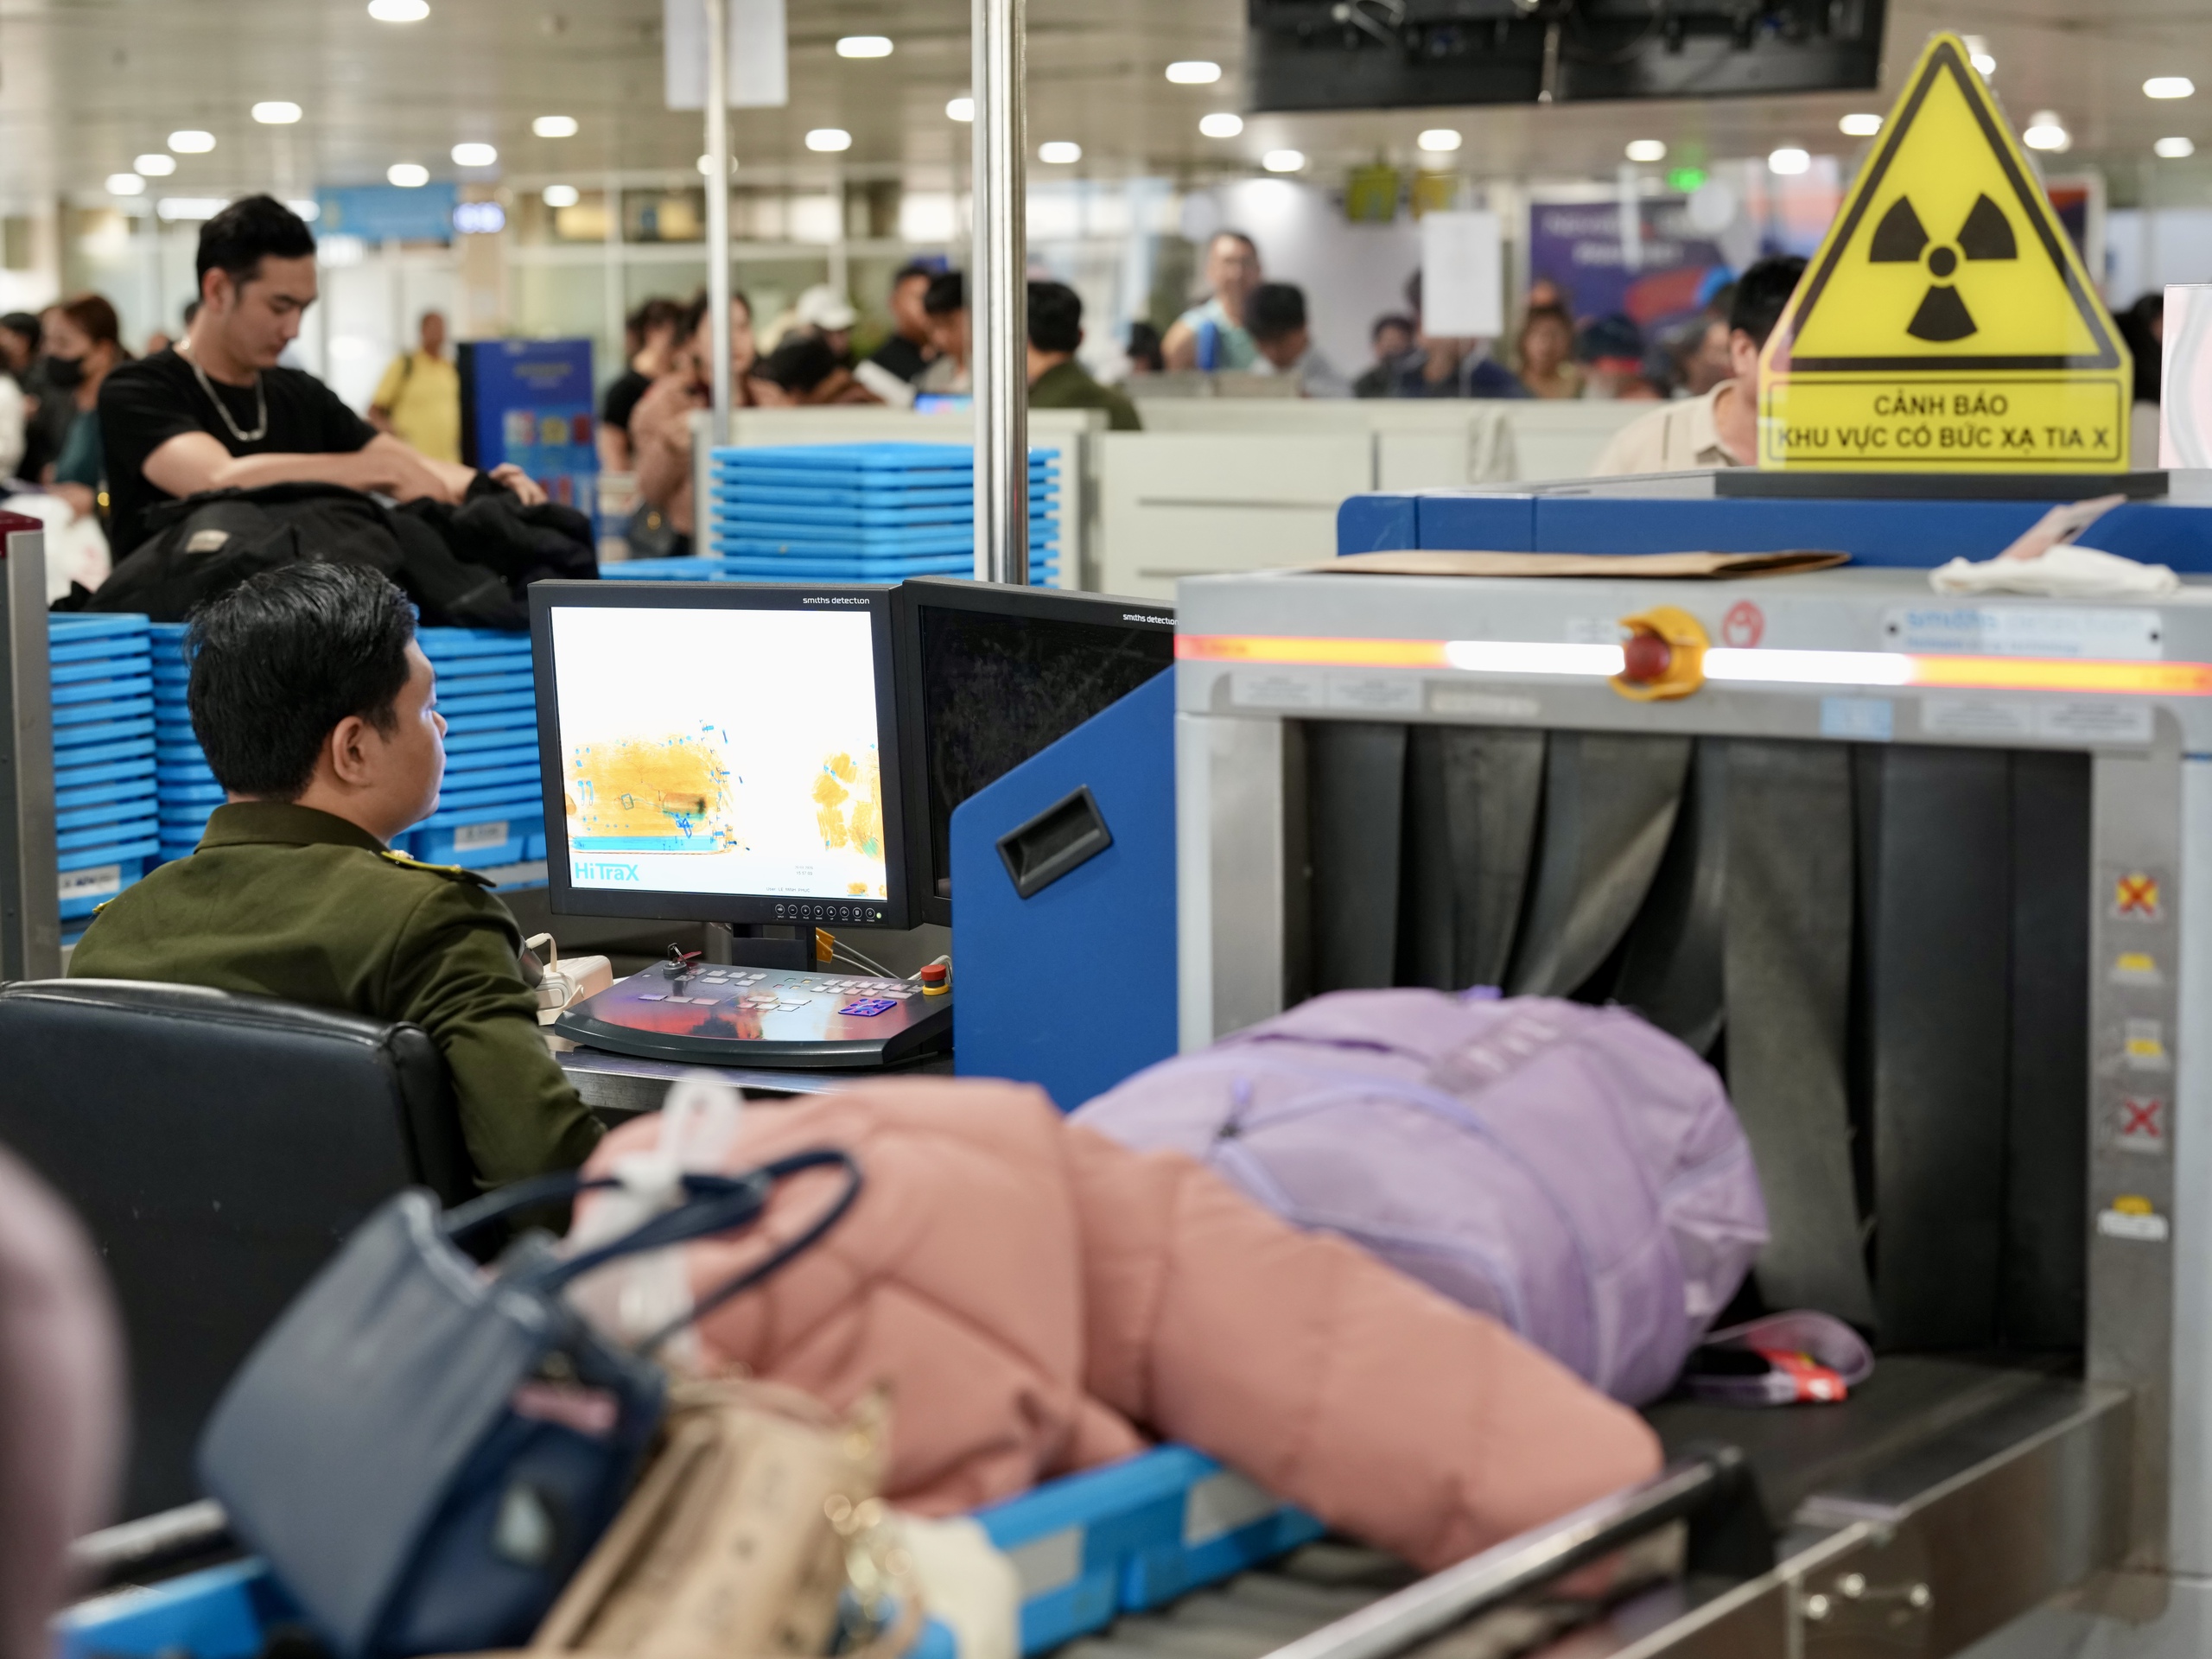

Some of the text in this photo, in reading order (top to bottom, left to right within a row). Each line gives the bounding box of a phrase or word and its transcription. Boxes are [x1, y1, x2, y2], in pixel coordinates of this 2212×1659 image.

[1873, 389, 2008, 416] CẢNH BÁO
[1778, 421, 2109, 454] KHU VỰC CÓ BỨC XẠ TIA X
[1122, 613, 1147, 622] smiths
[575, 862, 639, 881] HiTraX
